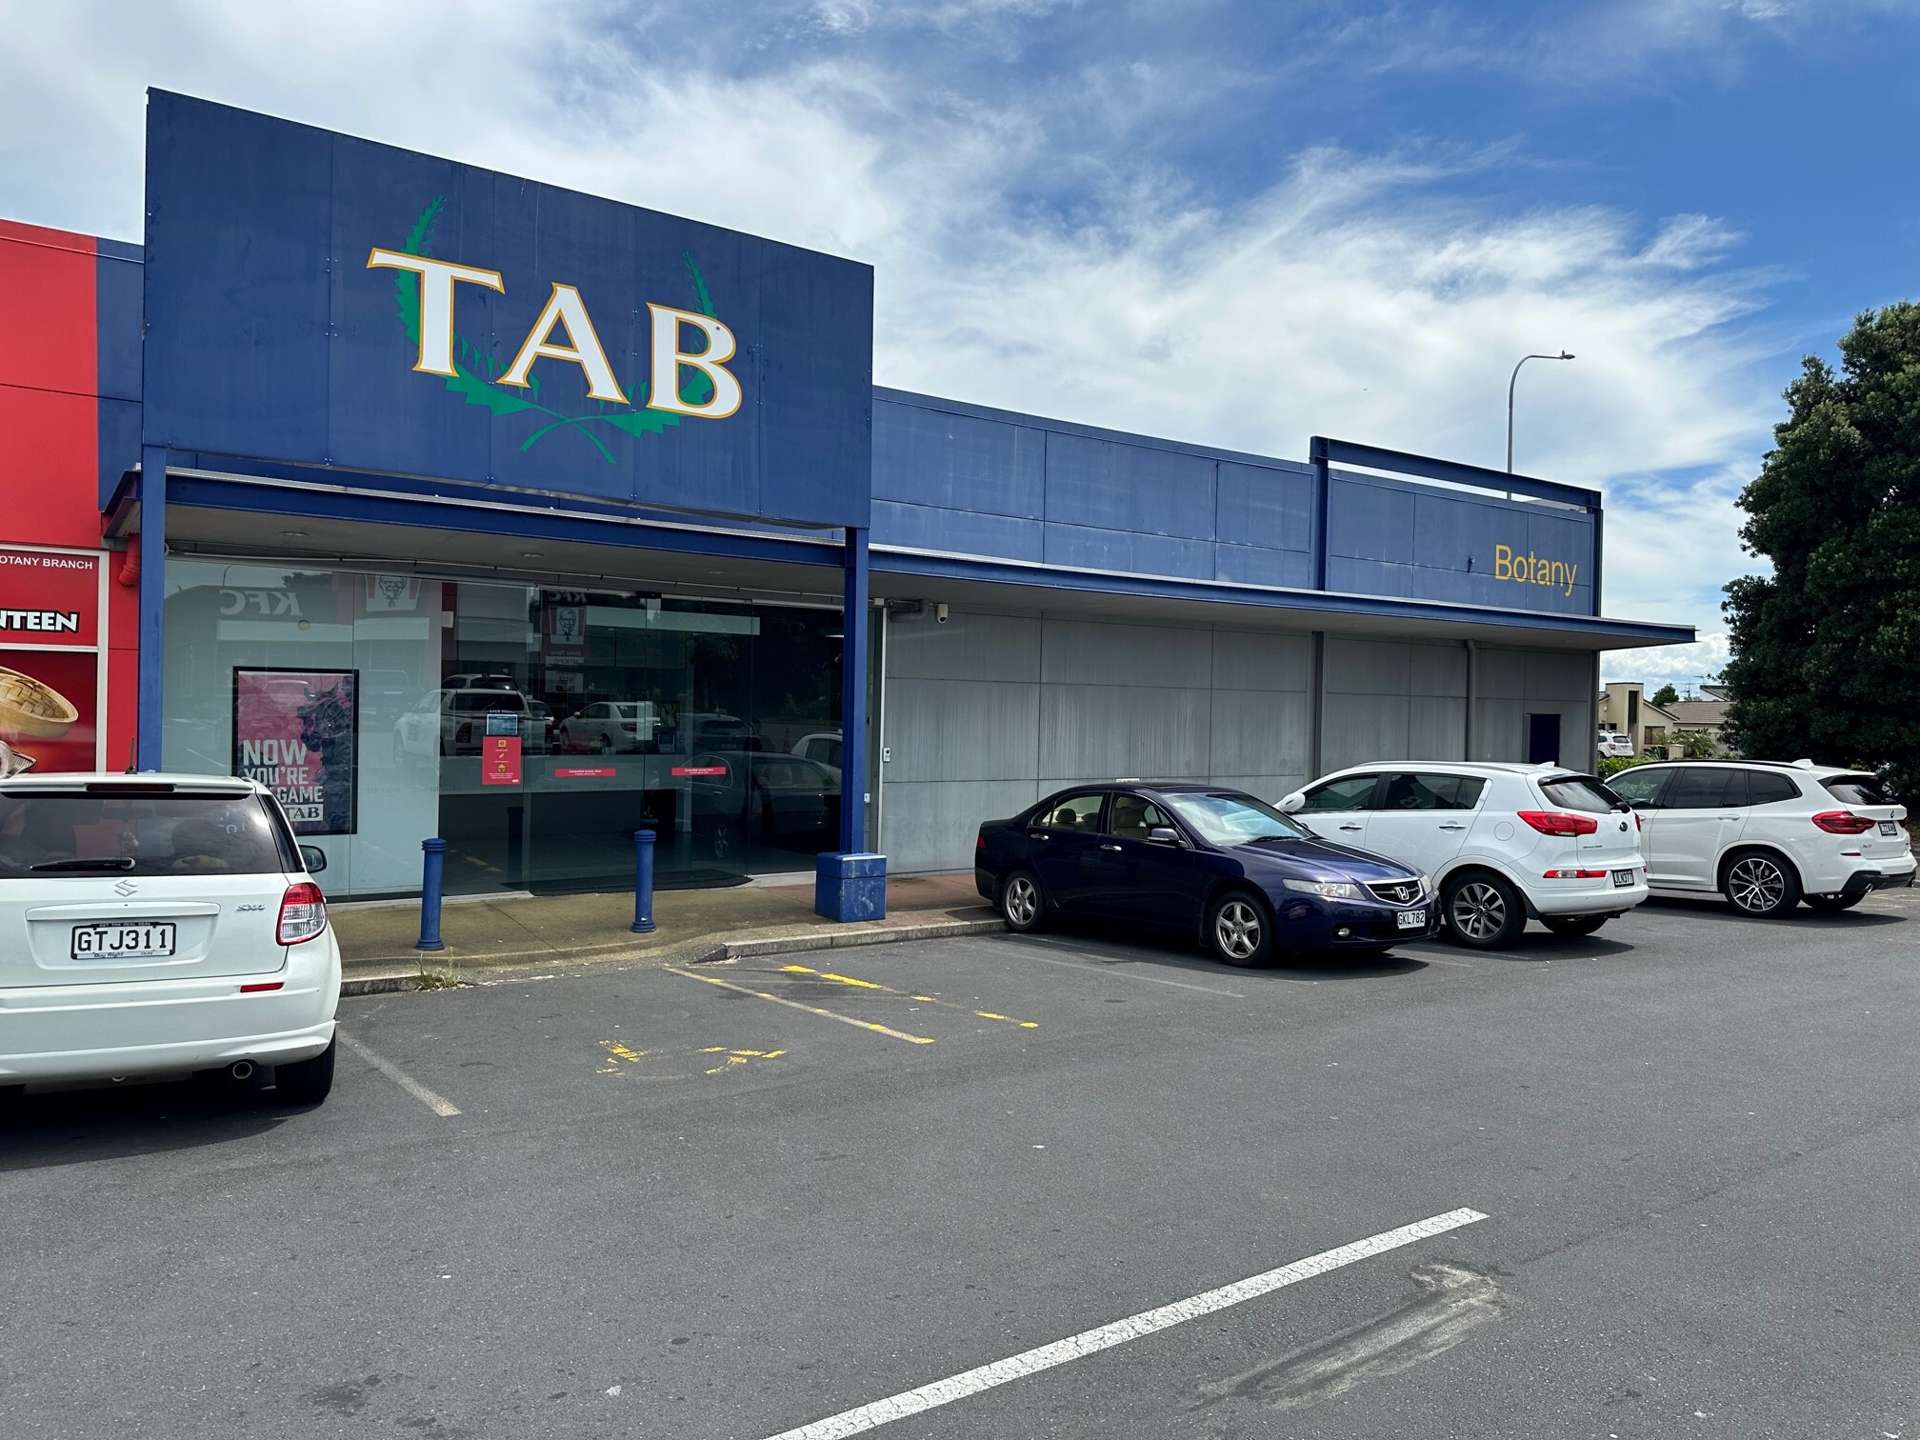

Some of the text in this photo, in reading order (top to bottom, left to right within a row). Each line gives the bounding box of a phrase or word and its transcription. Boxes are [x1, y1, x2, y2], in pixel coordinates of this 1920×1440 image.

[366, 247, 743, 419] TAB
[42, 558, 93, 570] BRANCH
[1495, 543, 1577, 597] Botany
[243, 739, 307, 766] NOW
[244, 767, 309, 785] YOU'RE
[276, 786, 324, 803] GAME
[1399, 912, 1425, 925] GKL782
[78, 929, 167, 952] GTJ311
